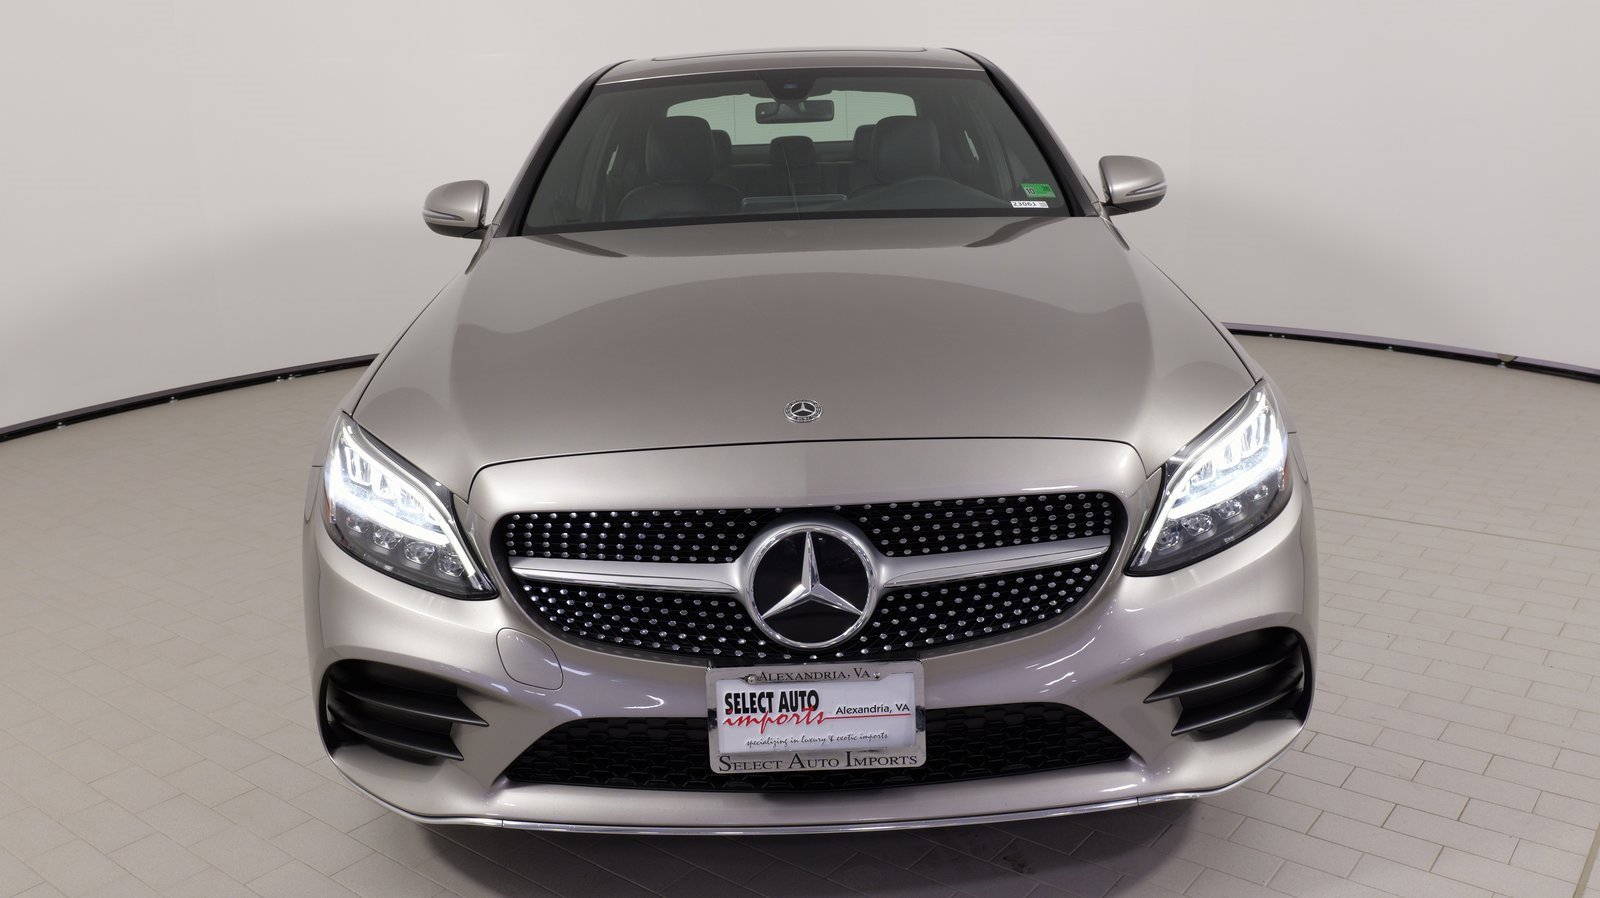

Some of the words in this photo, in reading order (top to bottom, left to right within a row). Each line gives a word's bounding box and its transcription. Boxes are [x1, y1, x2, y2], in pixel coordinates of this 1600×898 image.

[724, 691, 774, 715] SELECT
[778, 690, 819, 712] AUTO
[835, 704, 892, 715] Alexandria,
[895, 703, 910, 712] VA
[722, 705, 827, 734] imports
[745, 736, 788, 748] specializing
[800, 735, 826, 745] luxury
[836, 733, 857, 741] exotic
[859, 731, 888, 741] imports
